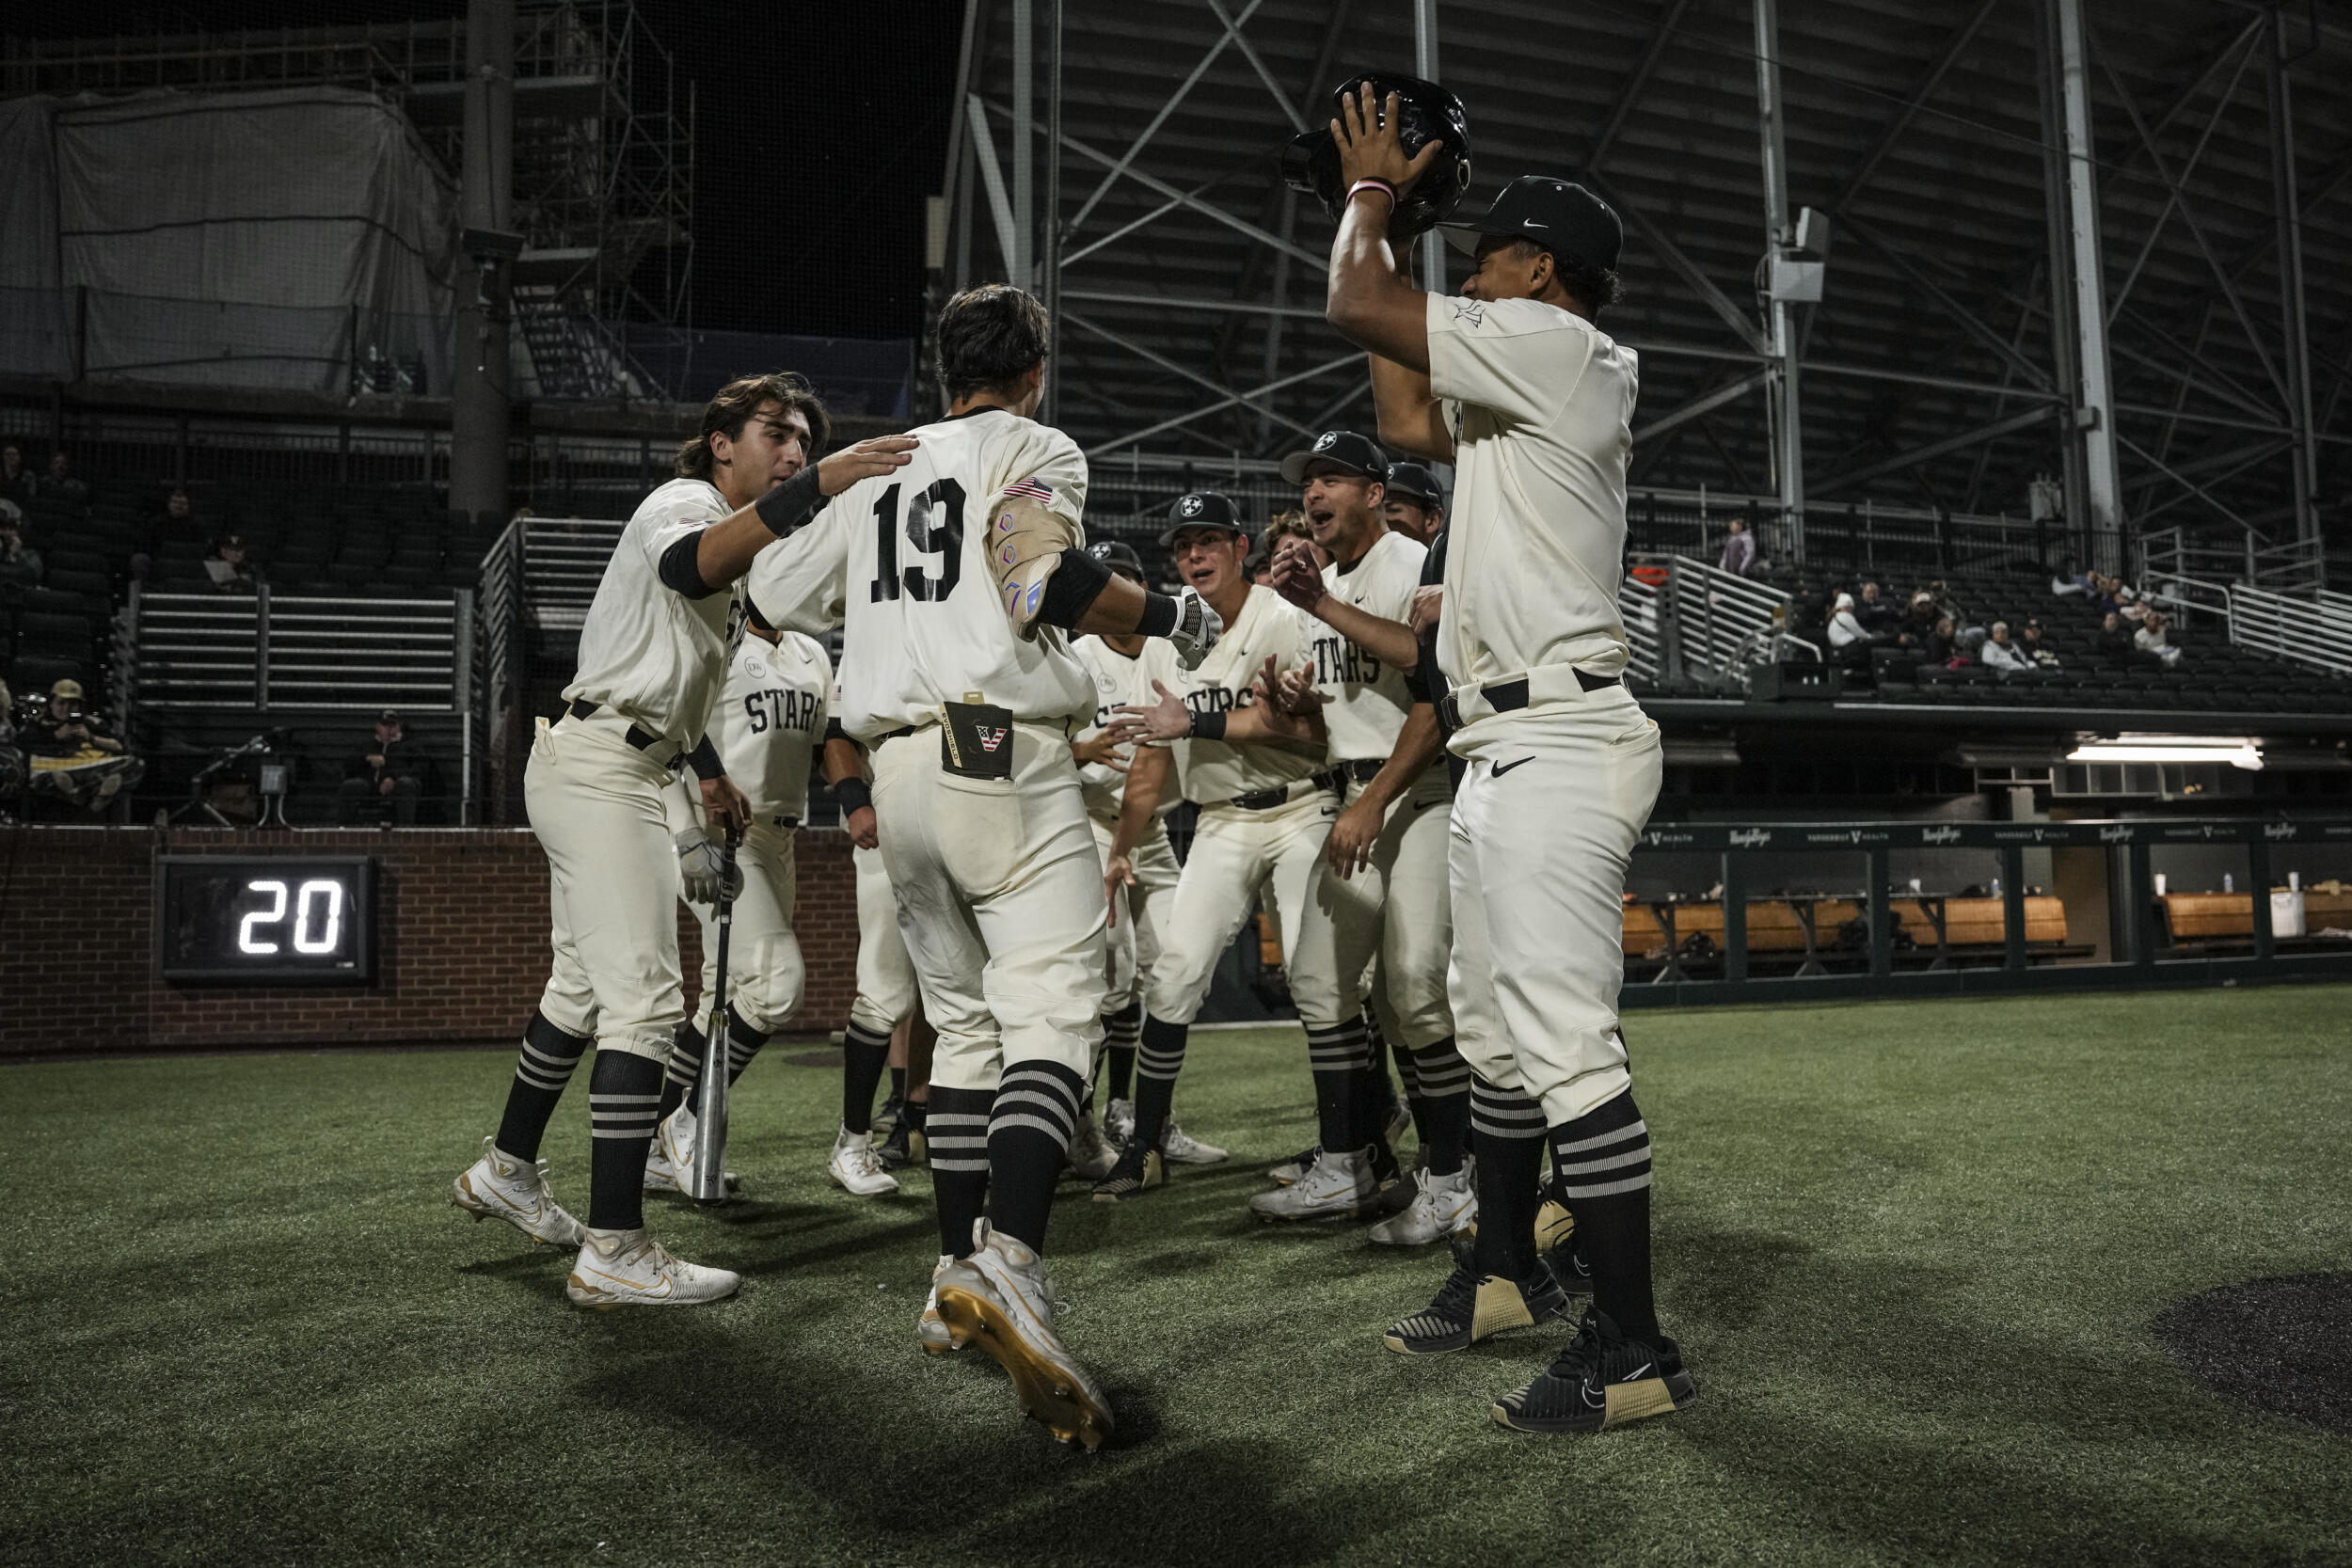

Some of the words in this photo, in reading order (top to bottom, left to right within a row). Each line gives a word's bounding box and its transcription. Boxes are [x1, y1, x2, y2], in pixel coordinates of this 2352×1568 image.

[871, 477, 966, 603] 19
[1313, 637, 1380, 684] TARS
[975, 725, 1009, 752] V
[238, 880, 343, 954] 20
